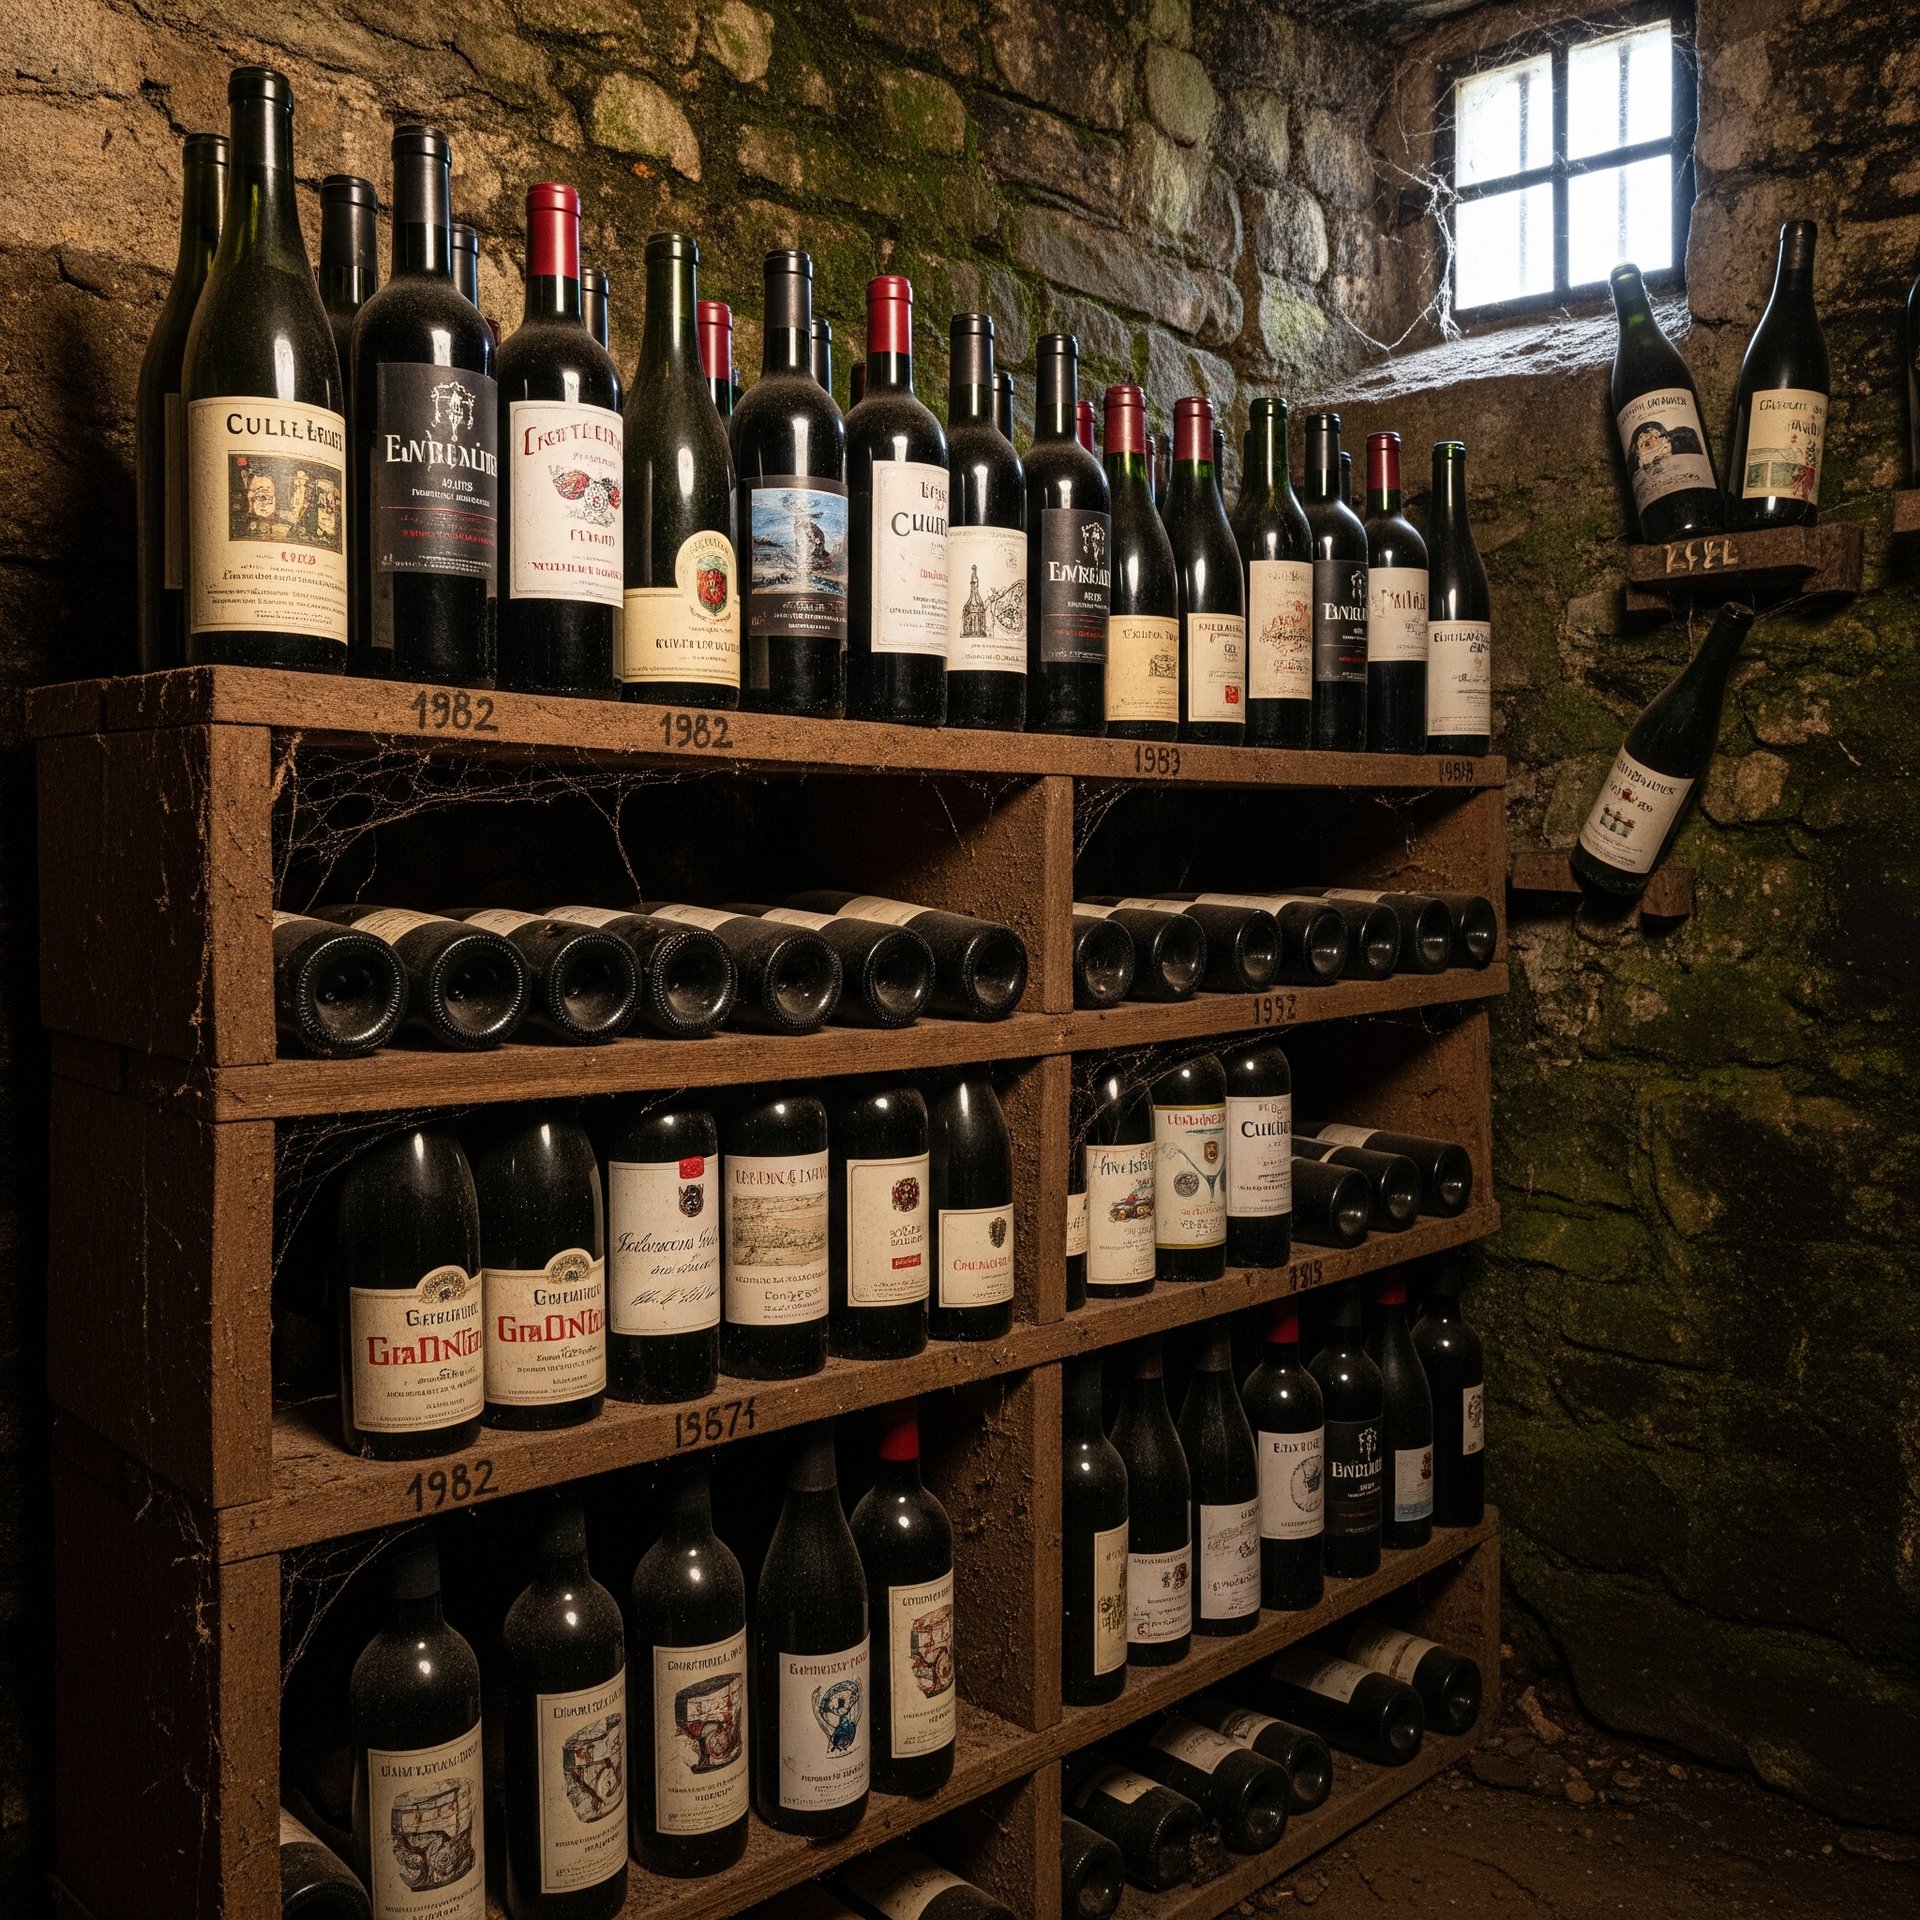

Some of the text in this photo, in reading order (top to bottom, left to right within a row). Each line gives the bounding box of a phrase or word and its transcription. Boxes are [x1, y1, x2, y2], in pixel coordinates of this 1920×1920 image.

[411, 690, 499, 732] 1982
[659, 711, 733, 748] 1982
[1133, 744, 1181, 775] 1983
[405, 1459, 499, 1513] 1982
